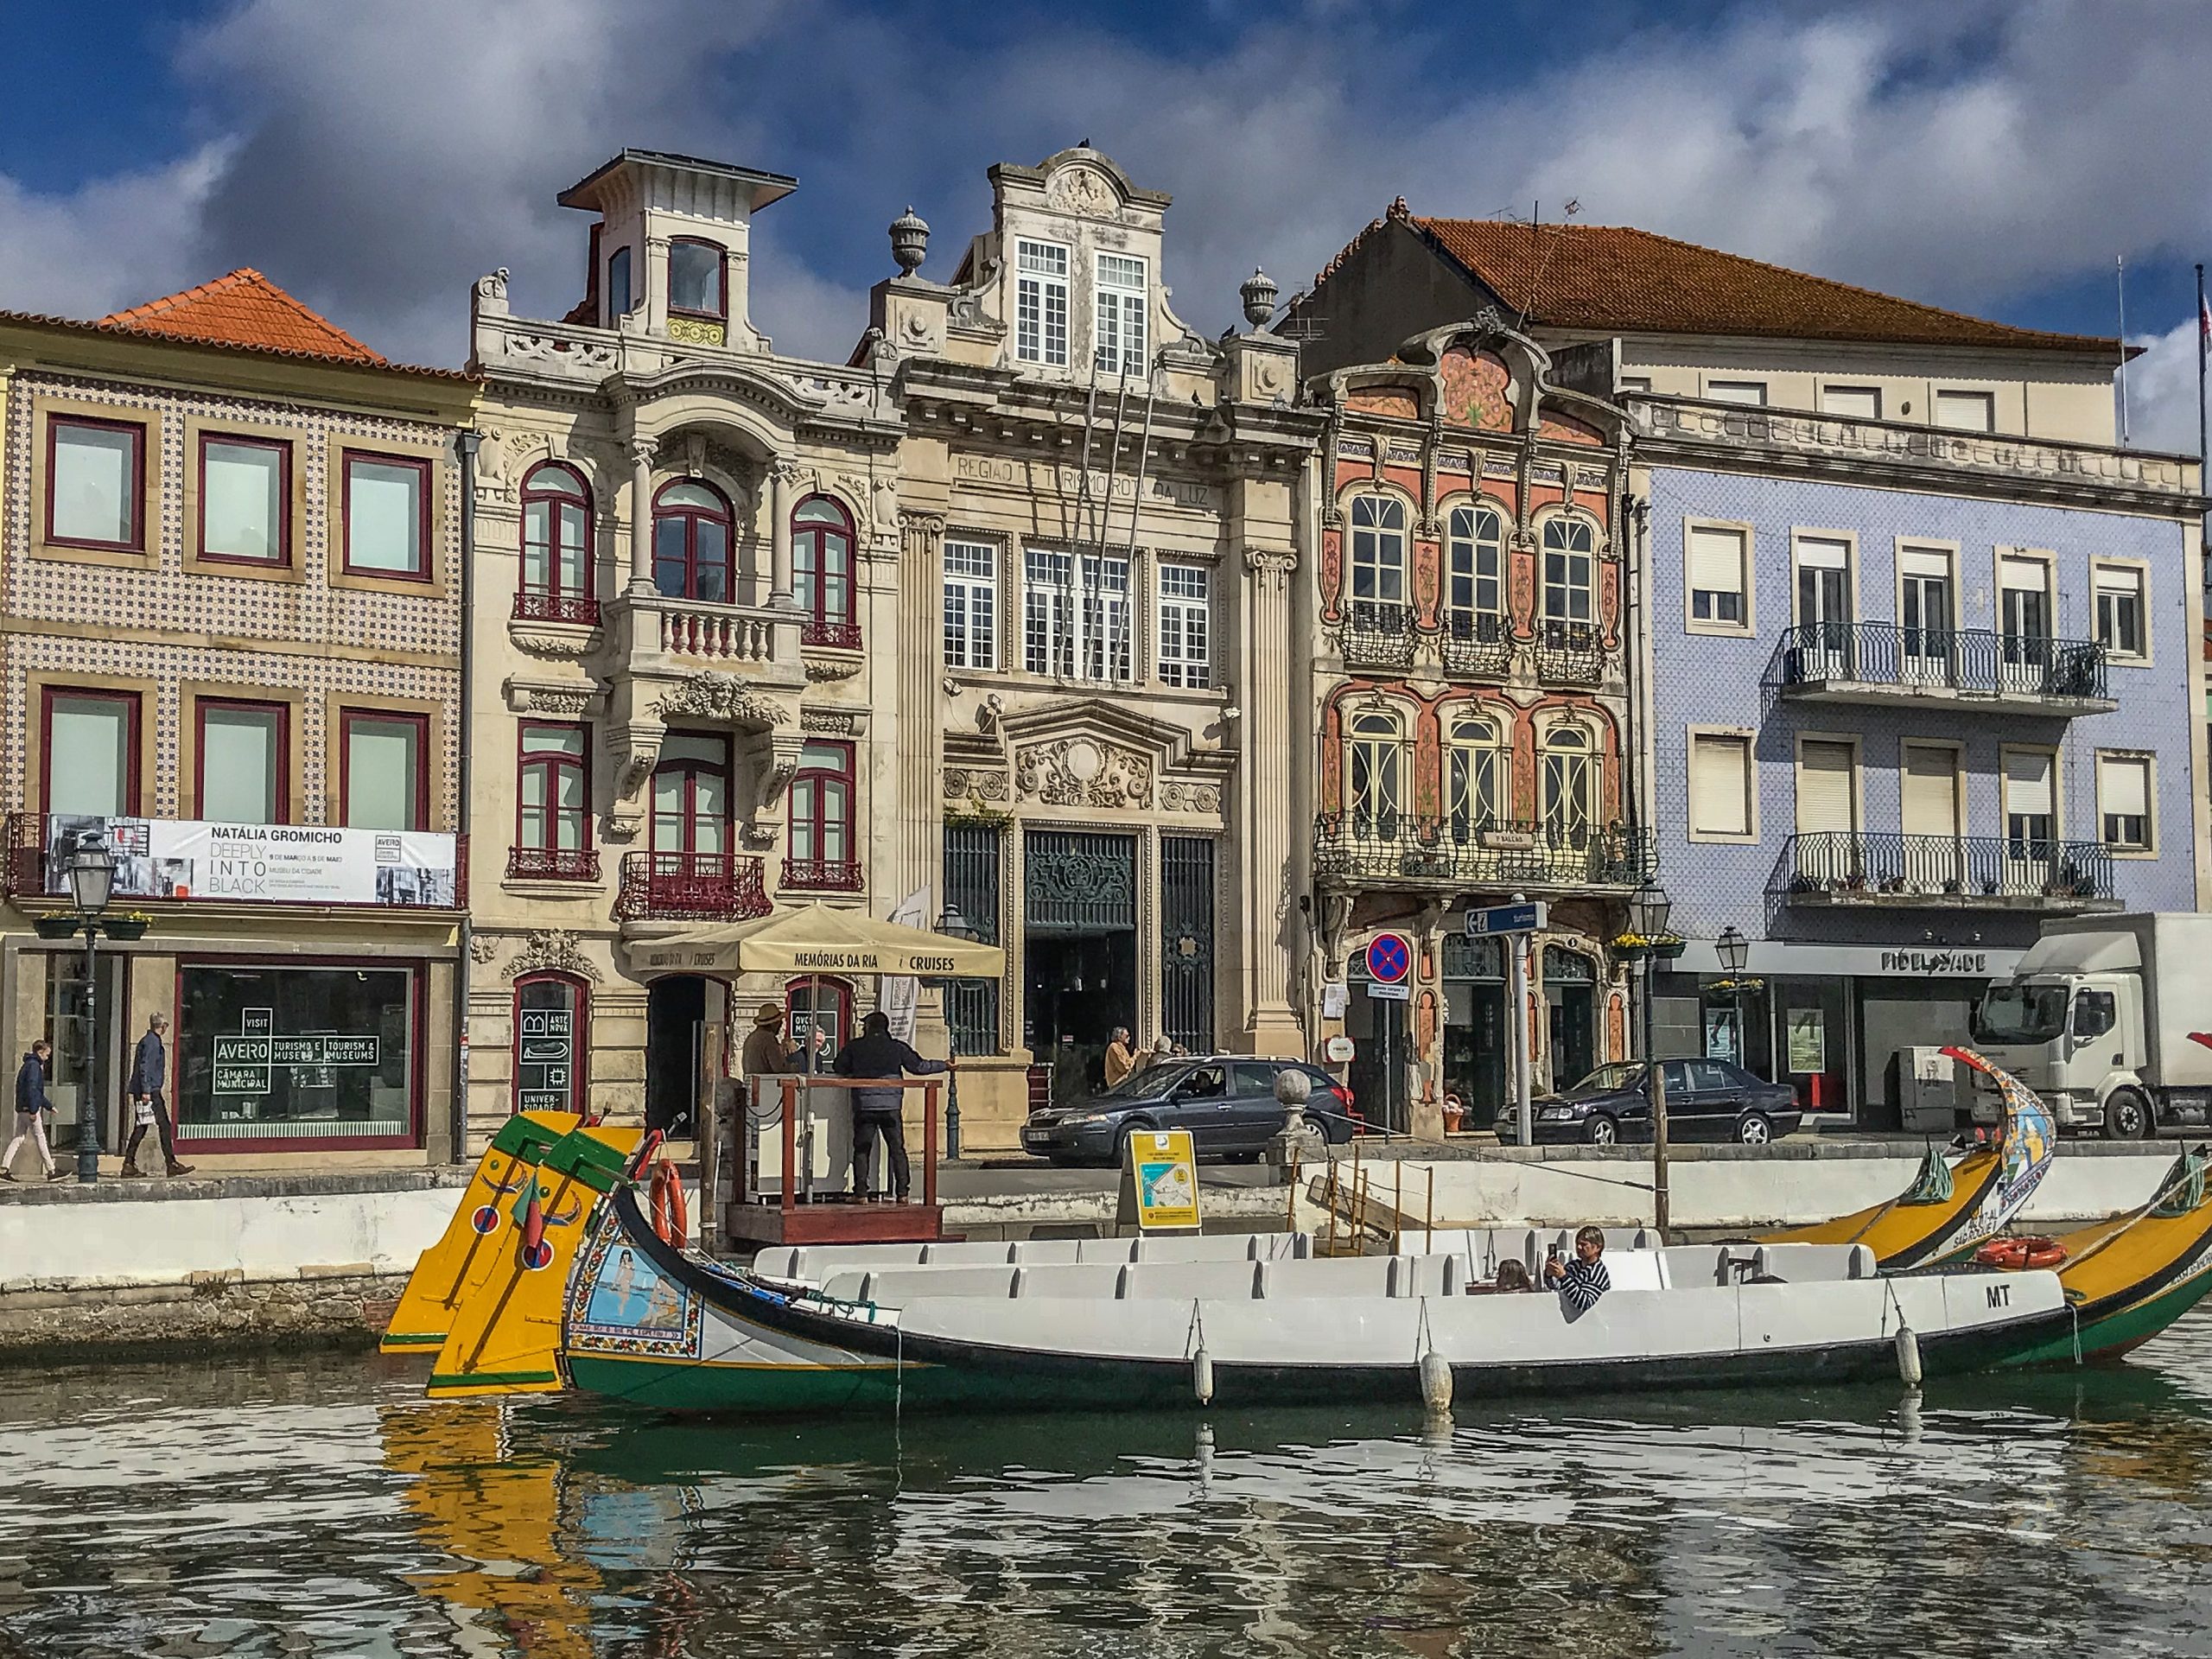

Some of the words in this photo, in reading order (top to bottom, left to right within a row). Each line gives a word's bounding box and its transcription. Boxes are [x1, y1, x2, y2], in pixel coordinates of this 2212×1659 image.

[1153, 482, 1174, 501] DA
[1179, 484, 1208, 505] LUZ
[211, 826, 267, 841] NATÁLIA
[270, 830, 342, 843] GROMICHO
[210, 842, 267, 859] DEEPLY
[210, 860, 266, 877] INTO
[209, 877, 265, 893] BLACK
[794, 950, 844, 968] MEMÓRIAS
[847, 954, 860, 968] DA
[862, 954, 878, 969] RIA
[909, 956, 955, 971] CRUISES
[246, 1018, 269, 1028] VISIT
[550, 1015, 569, 1024] ARTE
[274, 1041, 312, 1051] TURISMO
[315, 1041, 321, 1051] E
[328, 1041, 365, 1051] TOURISM
[368, 1041, 375, 1051] &
[329, 1051, 374, 1059] MUSEUMS
[217, 1079, 266, 1089] MUNICIPAL
[524, 1095, 560, 1103] UNIVER-
[524, 1103, 555, 1112] SIDADE
[1986, 1284, 2011, 1308] MT
